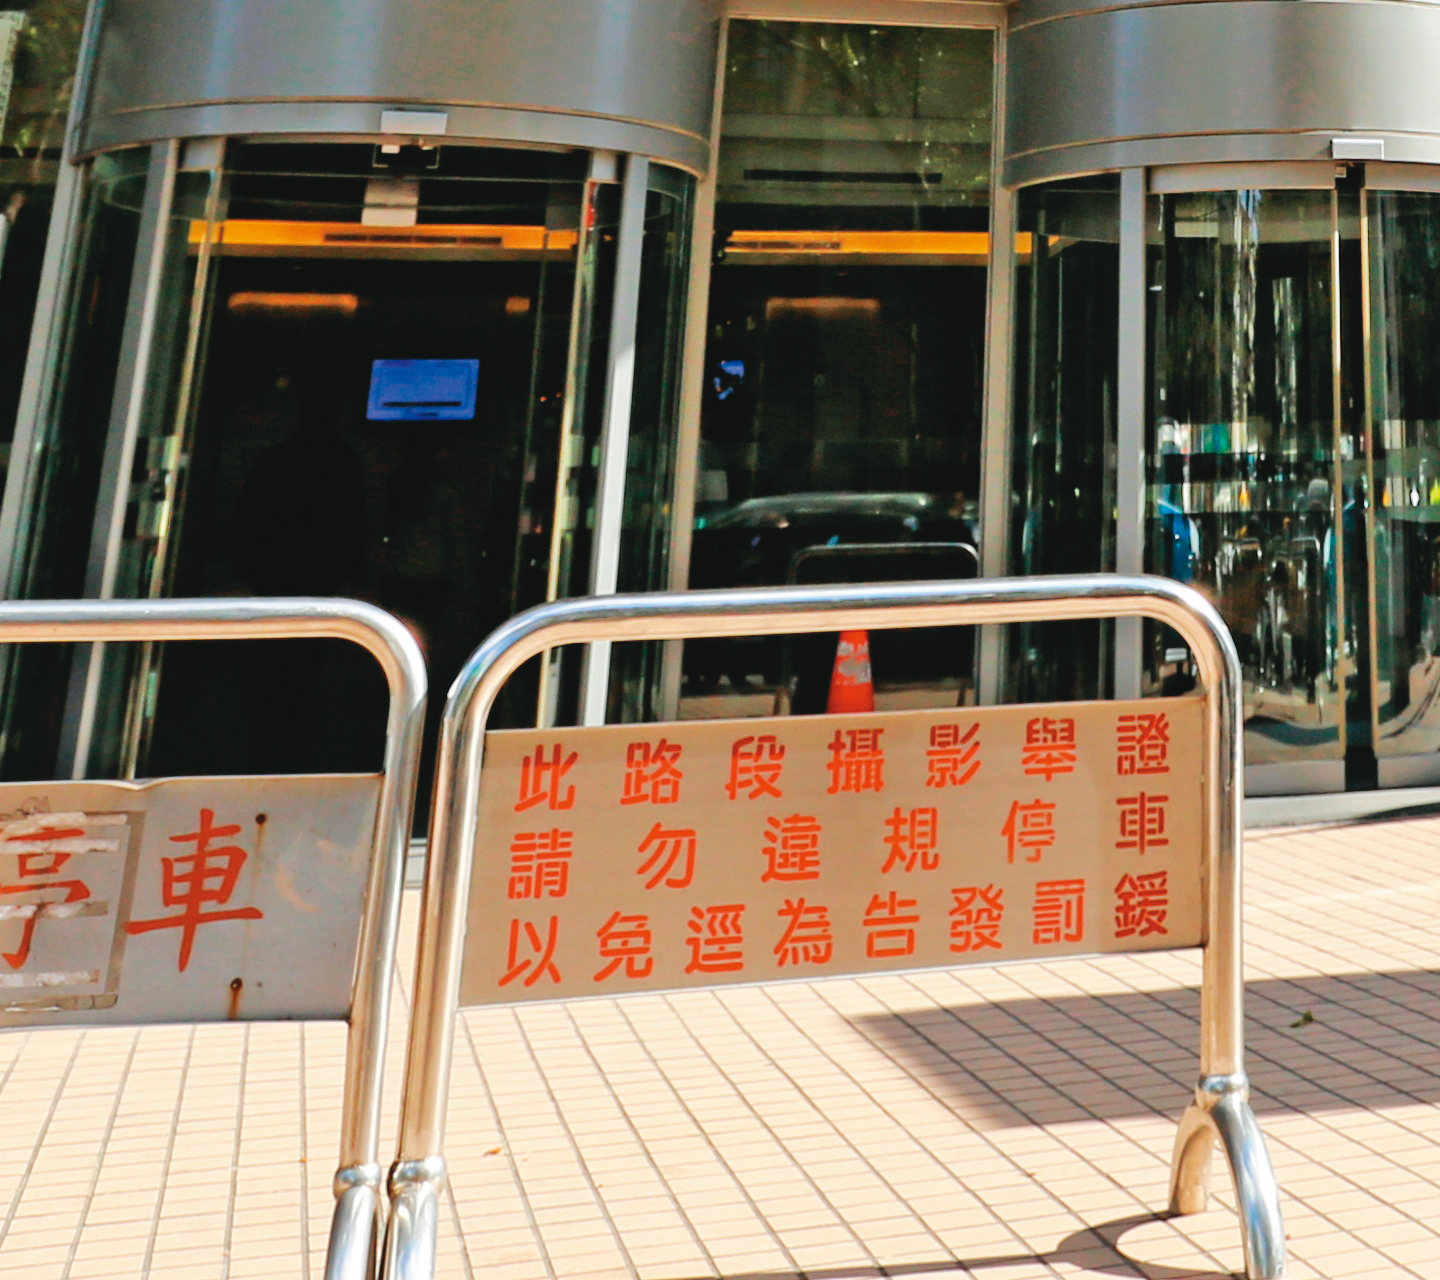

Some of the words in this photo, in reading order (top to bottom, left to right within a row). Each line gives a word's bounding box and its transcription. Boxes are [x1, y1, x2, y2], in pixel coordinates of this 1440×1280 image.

[513, 712, 1172, 814] 此路段攝影舉證
[506, 791, 1171, 901] 請勿違規停車
